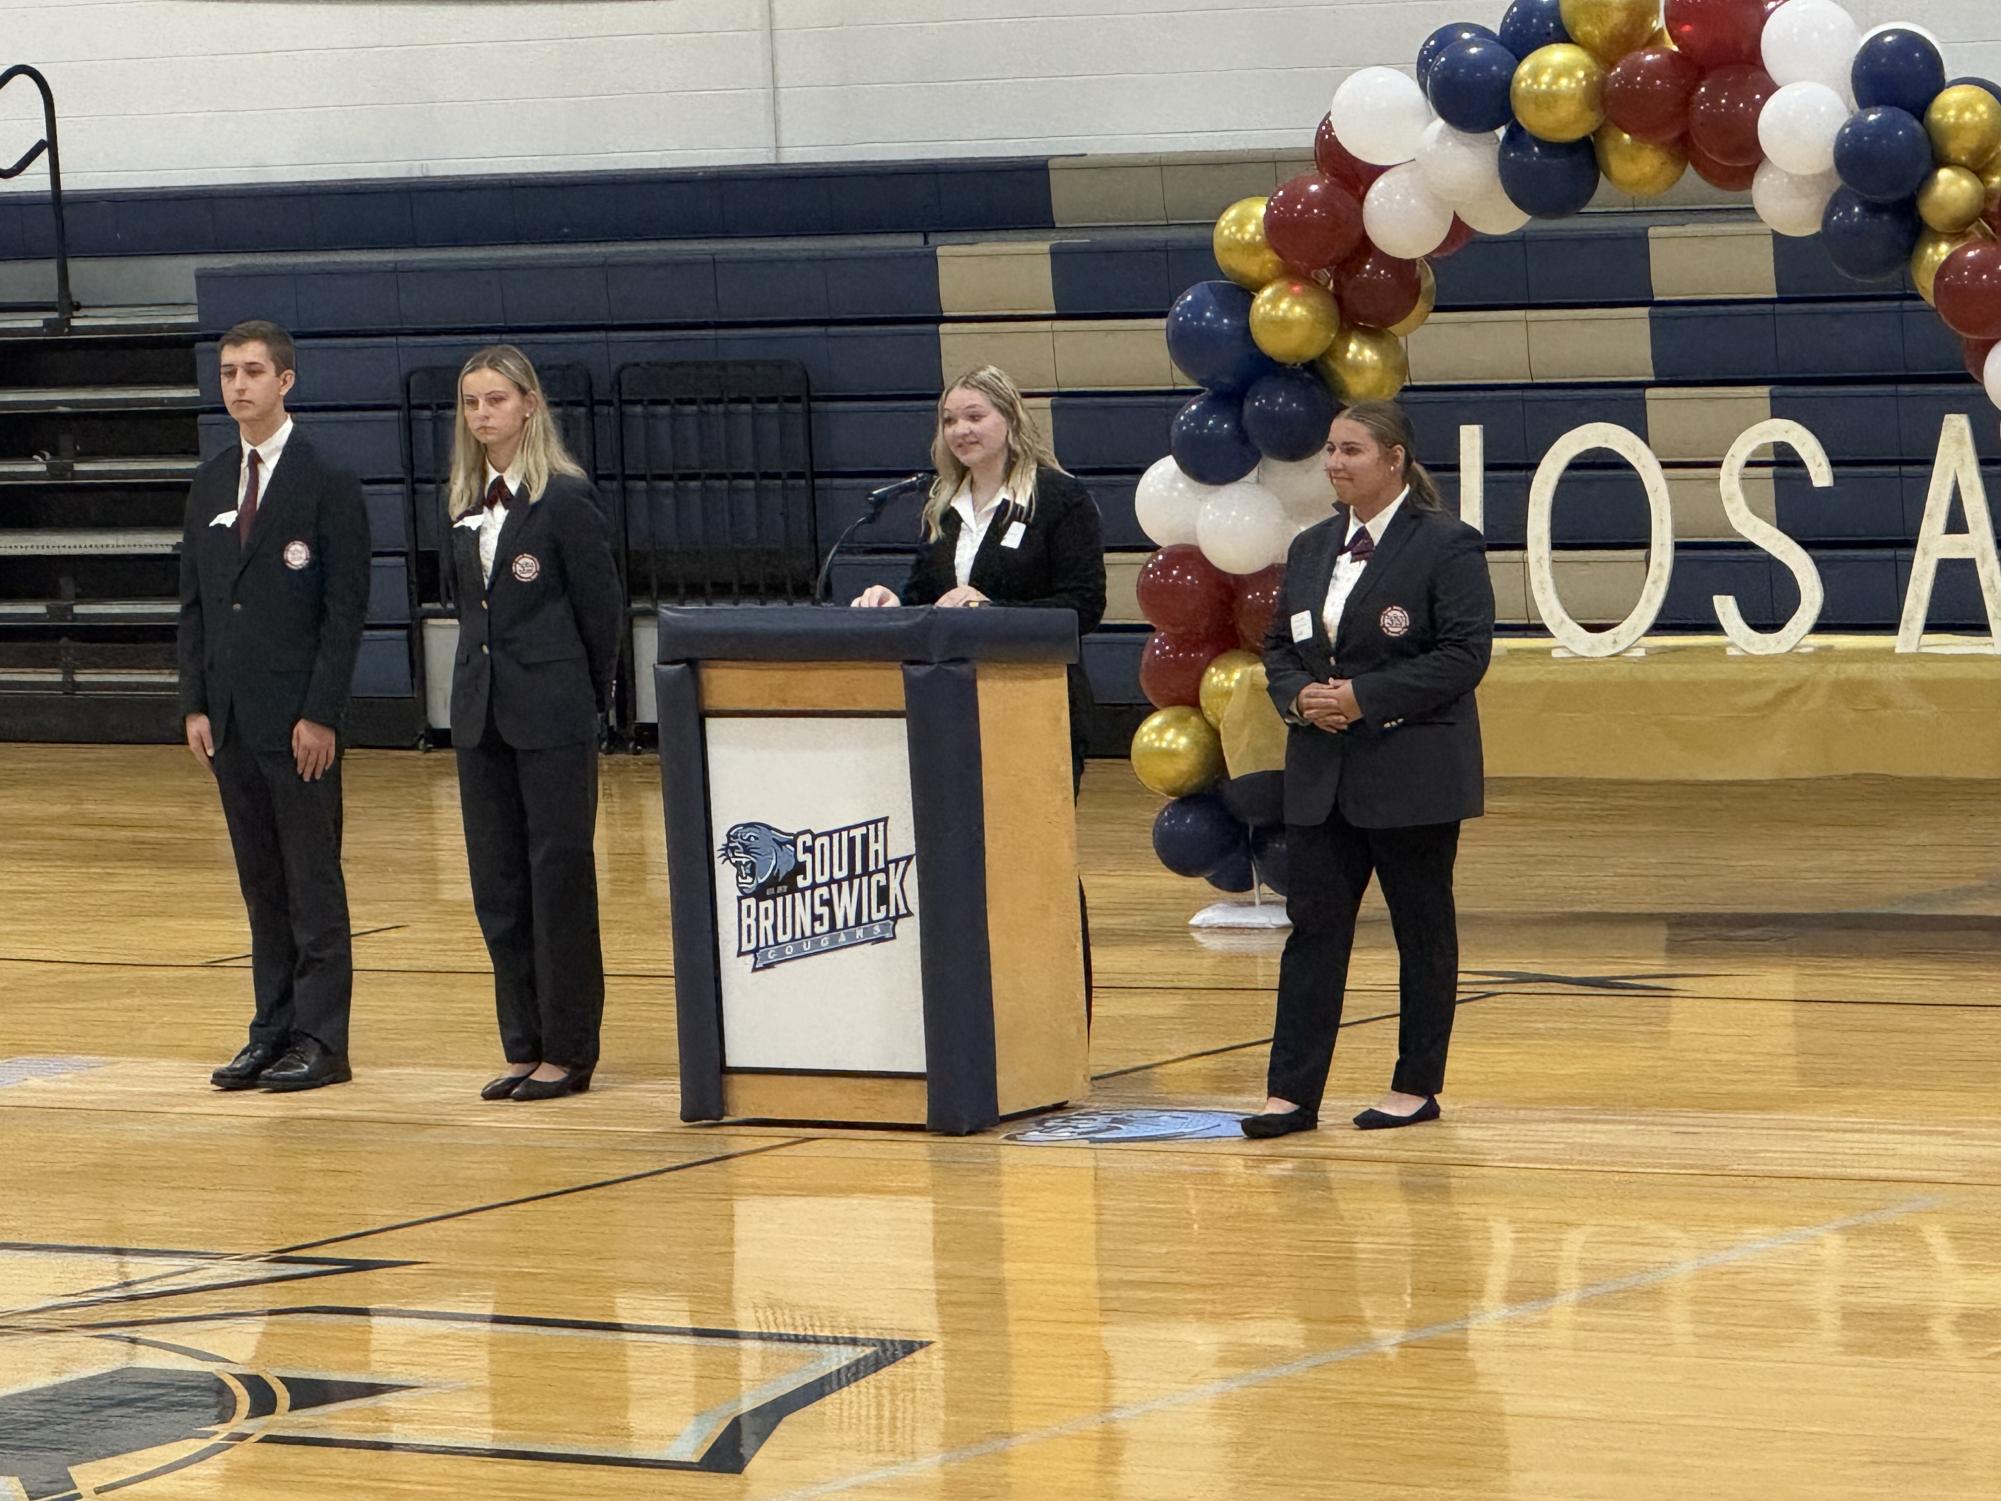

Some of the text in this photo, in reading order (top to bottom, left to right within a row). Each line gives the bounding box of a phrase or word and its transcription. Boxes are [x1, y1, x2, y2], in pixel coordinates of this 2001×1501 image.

[796, 821, 886, 888] SOUTH
[740, 860, 909, 952] BRUNSWICK
[767, 928, 881, 959] COUGARS
